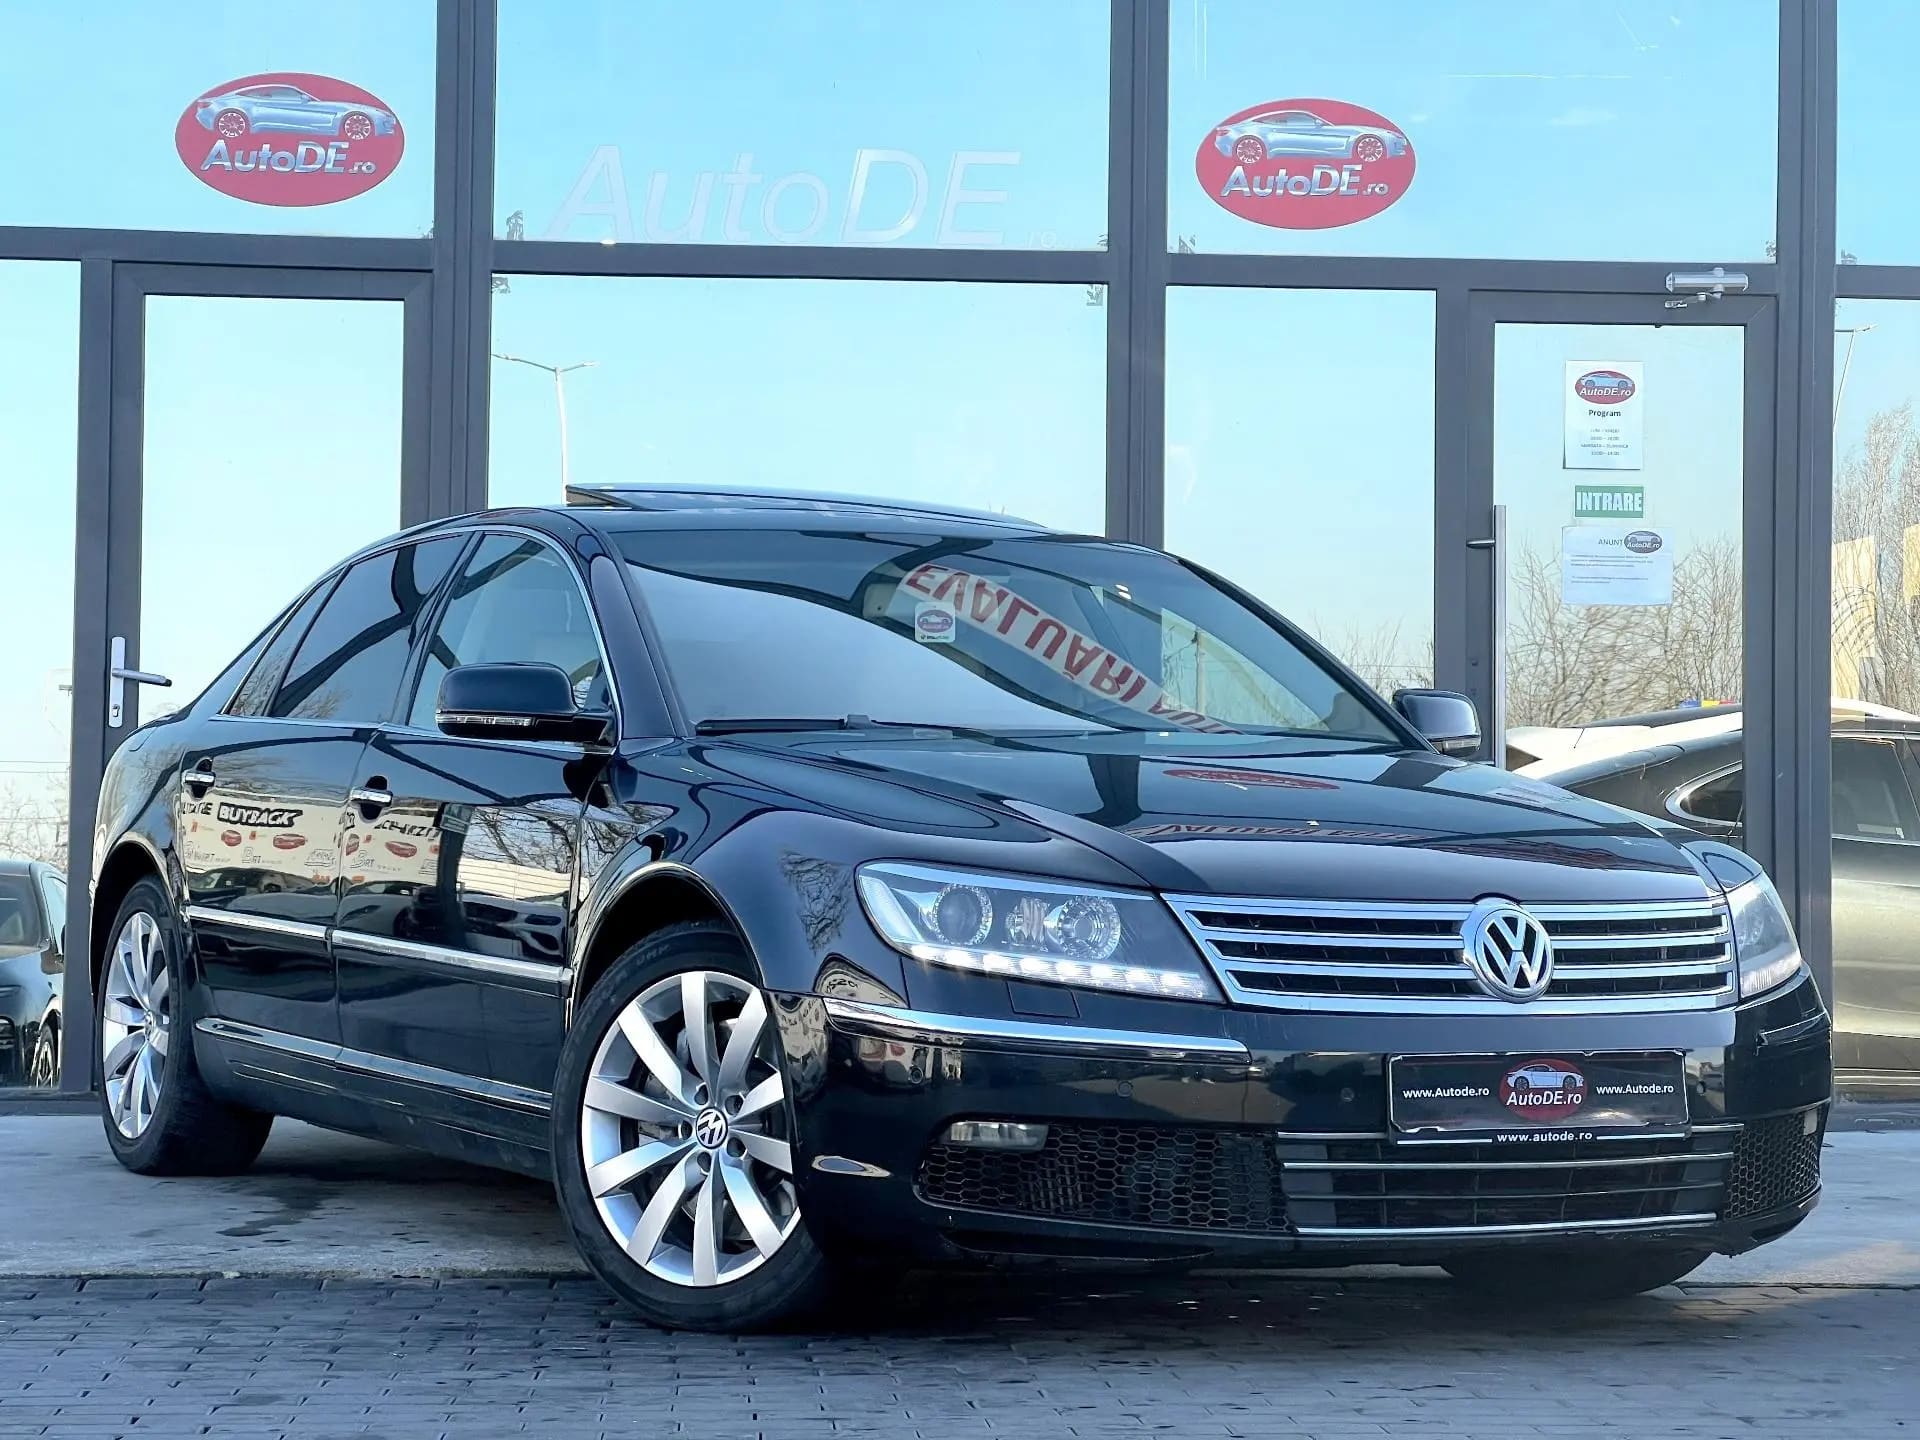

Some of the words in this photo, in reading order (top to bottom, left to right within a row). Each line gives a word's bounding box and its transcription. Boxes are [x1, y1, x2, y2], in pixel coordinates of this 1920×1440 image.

[1580, 387, 1632, 397] AutoDE.ro
[1588, 409, 1622, 418] Program
[1576, 491, 1643, 512] INTRARE
[1402, 1086, 1490, 1099] www.Autode.ro
[1506, 1090, 1583, 1107] AutoDE.ro
[1595, 1083, 1674, 1096] www.Autode.ro
[1496, 1130, 1593, 1143] www.autode.ro
